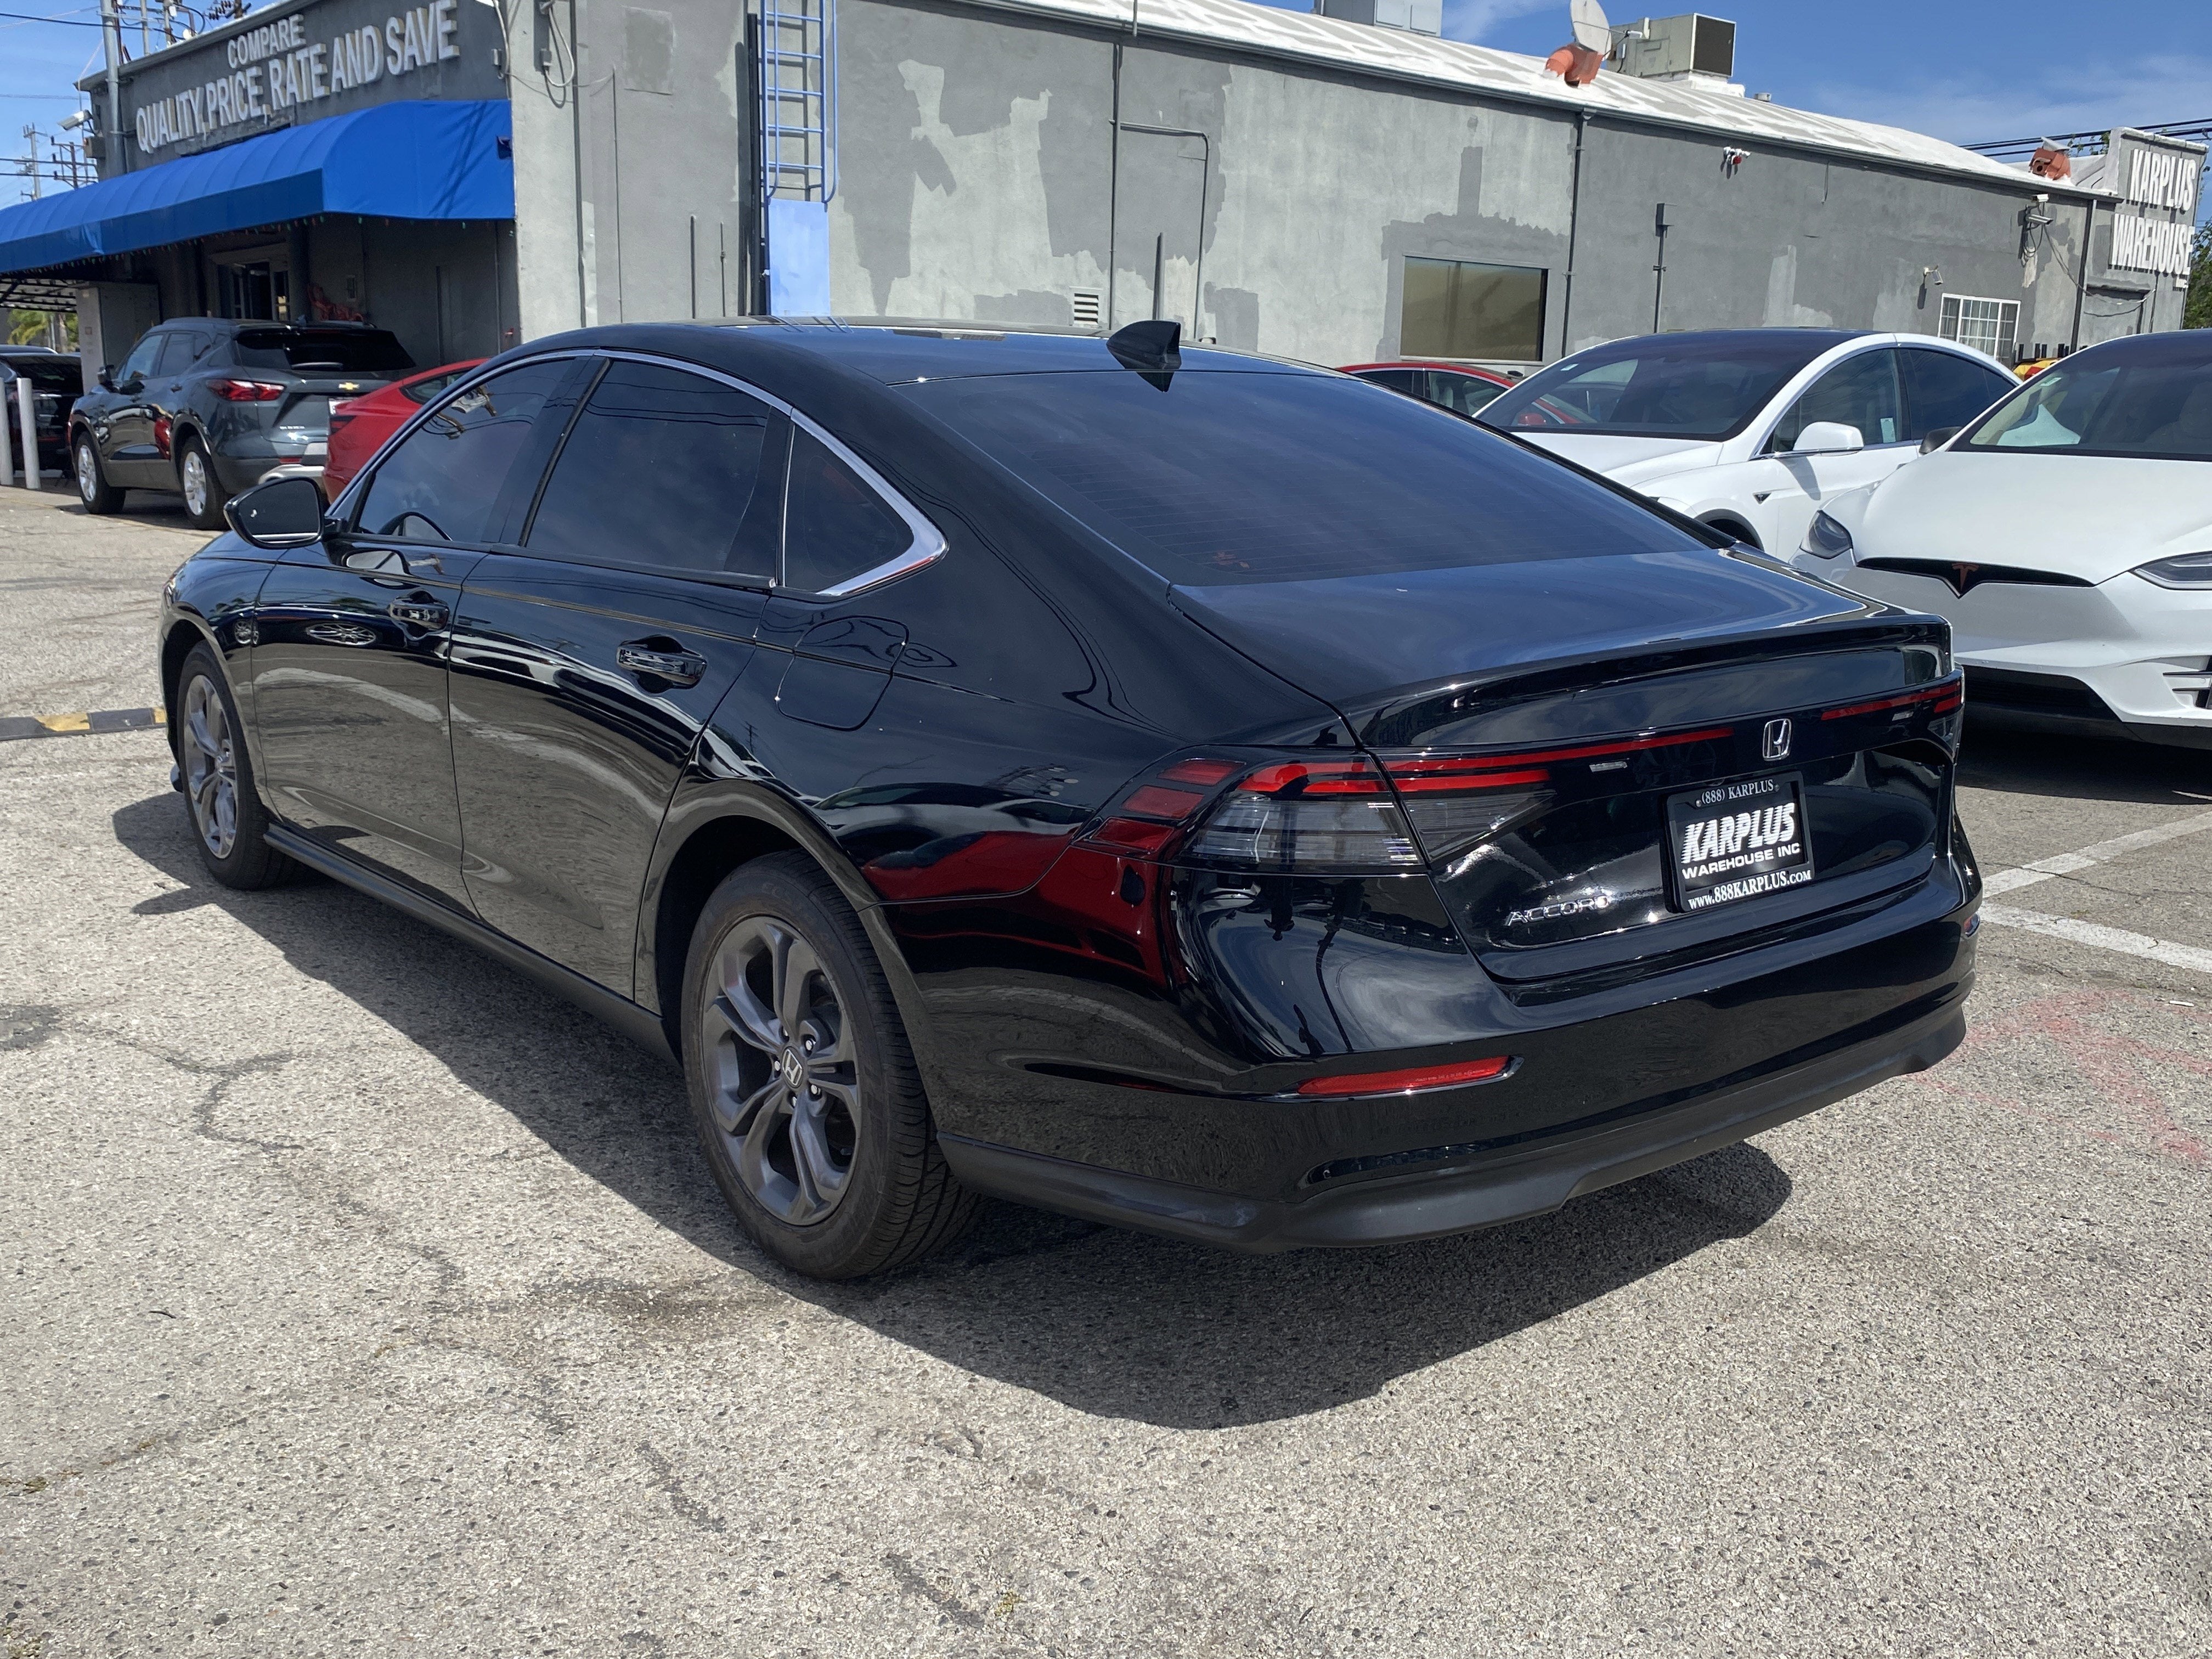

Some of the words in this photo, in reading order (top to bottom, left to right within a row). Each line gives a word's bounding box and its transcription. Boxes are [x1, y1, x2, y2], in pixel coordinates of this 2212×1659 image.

[228, 14, 307, 69] COMPARE
[268, 43, 330, 110] RATE
[331, 25, 384, 93] AND
[386, 0, 460, 75] SAVE
[2129, 149, 2196, 211] KARPLUS
[2112, 213, 2196, 275] WAREHOUSE
[1701, 788, 1725, 805] (888)
[1728, 779, 1774, 800] KARPLUS
[1681, 803, 1795, 864] KARPLUS
[1682, 849, 1774, 879] WAREHOUSE
[1778, 842, 1801, 857] INC
